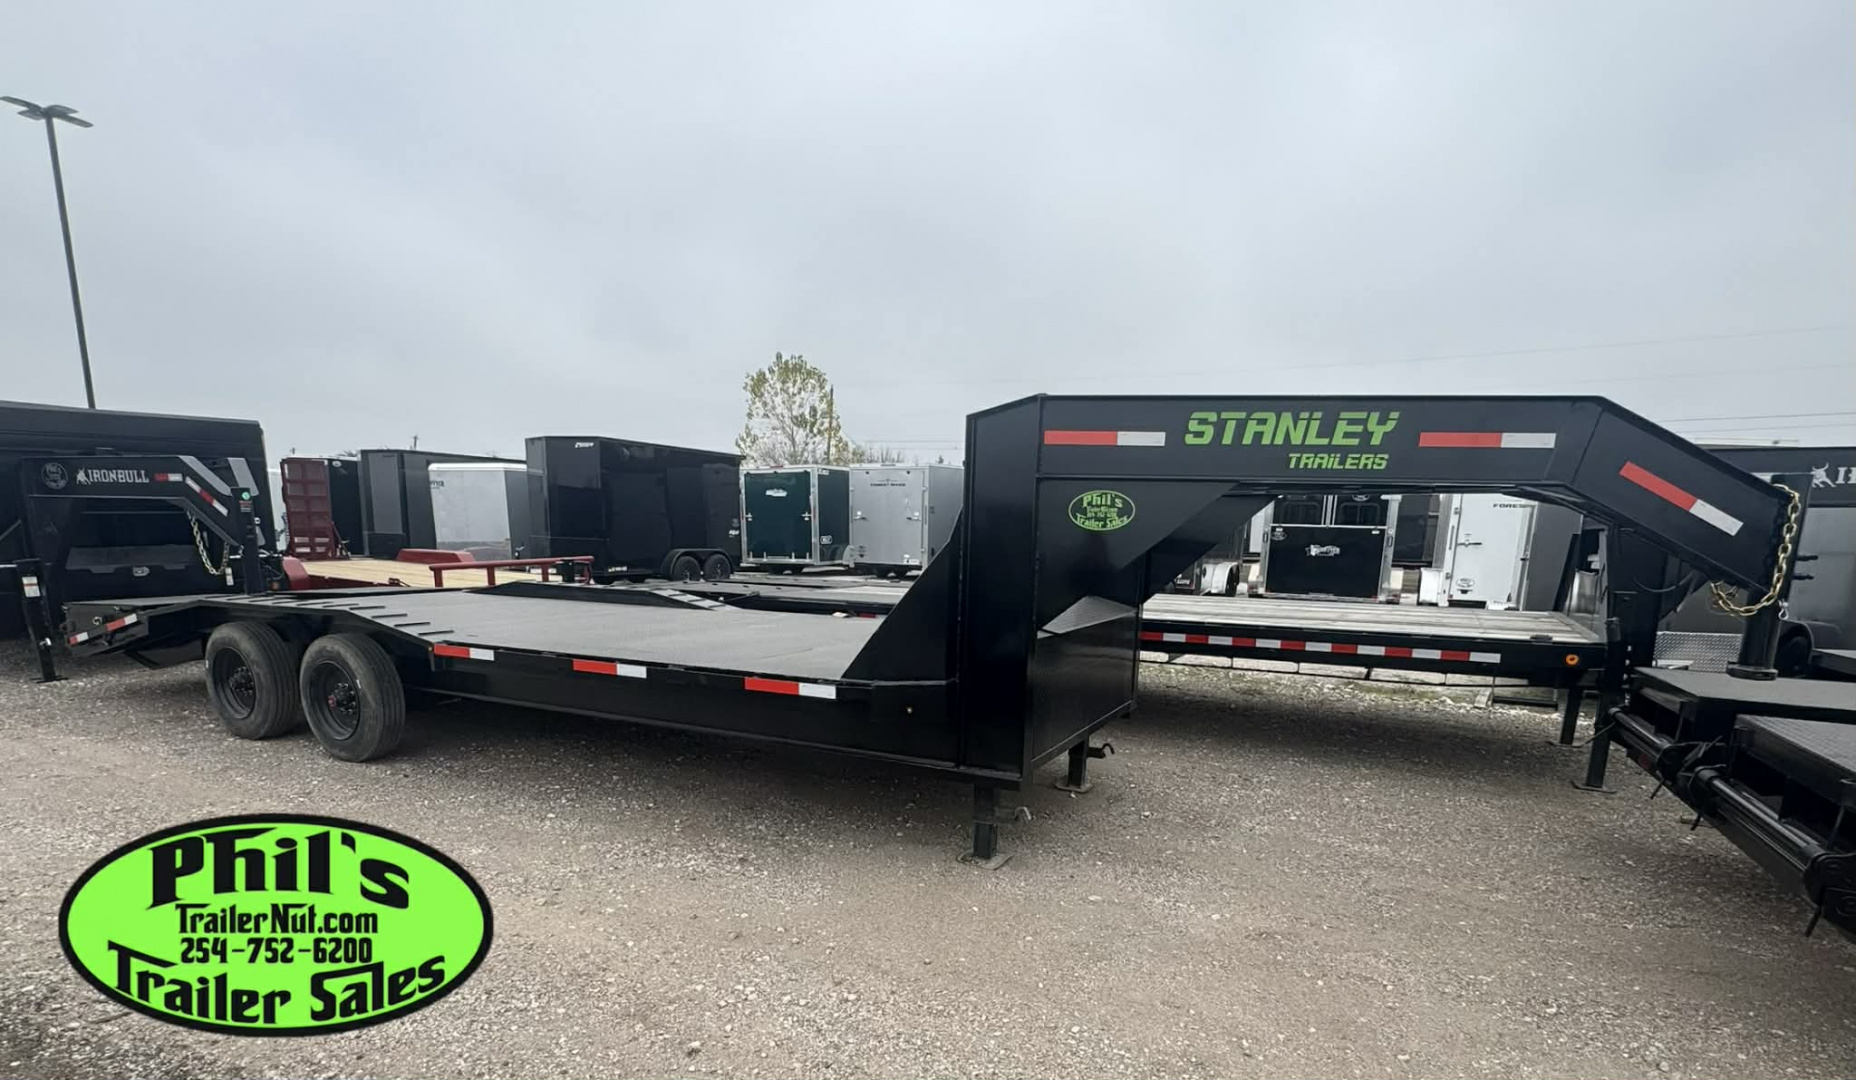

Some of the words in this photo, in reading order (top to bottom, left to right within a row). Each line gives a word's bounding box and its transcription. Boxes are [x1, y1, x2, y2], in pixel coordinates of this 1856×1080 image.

[1185, 411, 1400, 446] STANLEY
[1288, 453, 1389, 470] TRAILERS
[88, 469, 149, 483] IRONBULL
[1082, 493, 1123, 508] Phil's
